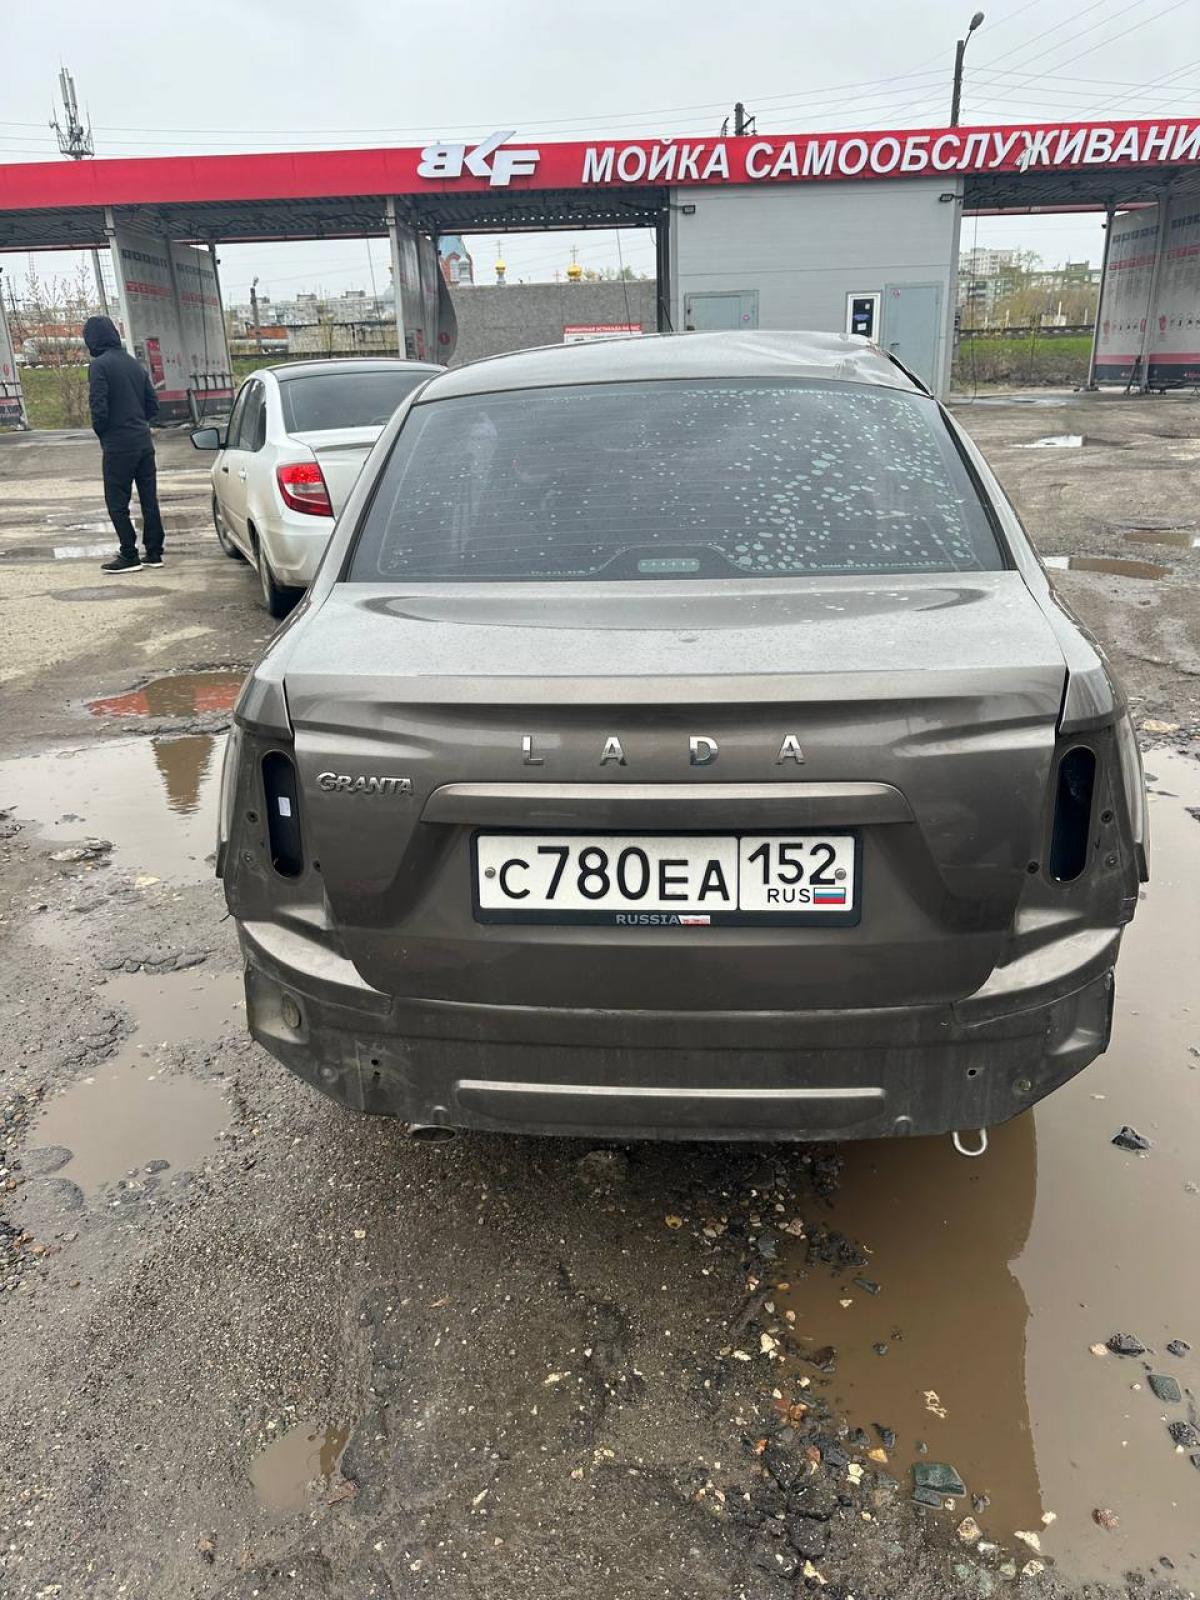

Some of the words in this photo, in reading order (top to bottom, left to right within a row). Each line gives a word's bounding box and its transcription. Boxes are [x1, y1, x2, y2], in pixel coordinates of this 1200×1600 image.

[581, 138, 731, 184] МОЙКА
[745, 124, 1200, 179] САМООБСЛУЖИВАНИ
[521, 733, 805, 766] LADA
[316, 771, 413, 795] GRANTA
[748, 843, 836, 885] 152
[767, 888, 811, 904] RUS
[615, 914, 680, 925] RUSSIA
